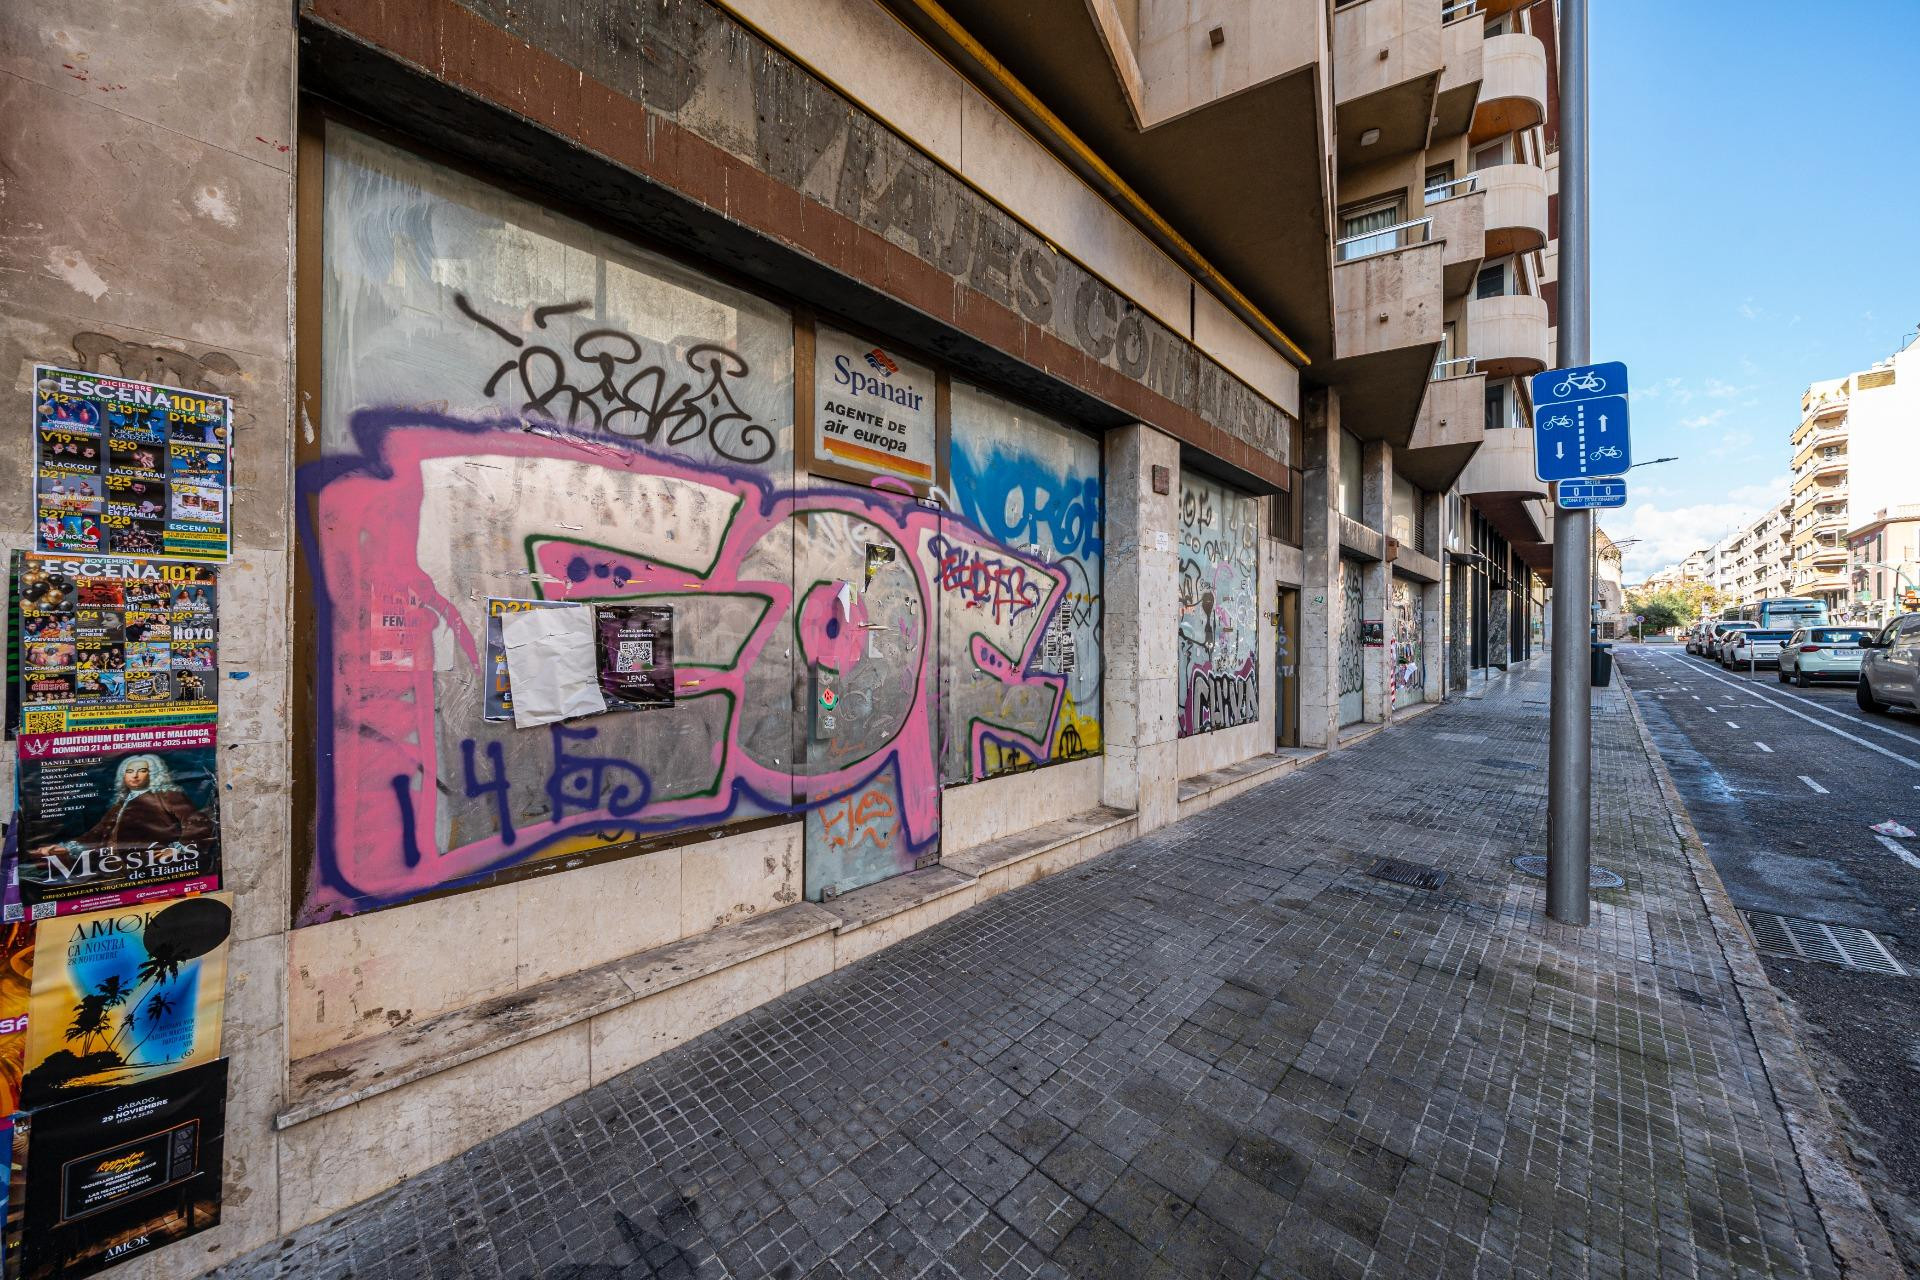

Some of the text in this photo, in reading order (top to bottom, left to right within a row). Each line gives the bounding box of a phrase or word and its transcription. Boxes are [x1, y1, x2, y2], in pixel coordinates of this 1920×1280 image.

[101, 380, 152, 392] DICIEMBRE
[834, 354, 923, 412] Spanair
[169, 412, 197, 424] D14
[824, 401, 907, 435] AGENTE DE
[41, 431, 72, 443] V19
[824, 419, 907, 453] air europa
[108, 439, 138, 450] S20
[170, 445, 195, 457] D21
[45, 460, 97, 471] BLACKOUT
[39, 469, 66, 479] D21
[105, 475, 132, 487] J25
[39, 509, 65, 518] S27
[101, 514, 131, 525] D28
[123, 511, 157, 519] FAMILIA
[76, 580, 92, 588] S1
[173, 625, 214, 640] HOYO
[76, 642, 101, 650] S22
[125, 671, 150, 679] D30
[627, 674, 647, 682] LENS
[53, 729, 209, 746] AUDITORIUM DE PALMA DE MALLORCA
[52, 746, 89, 754] DOMINGO
[91, 744, 100, 752] 21
[113, 740, 152, 750] DICIEMBRE
[41, 757, 102, 767] DANIEL MULET
[99, 846, 115, 857] El
[41, 841, 199, 883] Mesías
[129, 860, 199, 880] de Händel
[67, 889, 94, 897] BALEAR
[100, 882, 136, 891] ORQUESTA
[171, 871, 199, 879] EUROPEA
[67, 938, 125, 958] CA NOSTRA
[79, 951, 119, 964] NOVIEMBRE
[101, 1099, 169, 1124] 29 NOVIEMBRE
[100, 1182, 127, 1195] MEJORES
[127, 1174, 149, 1186] FIESTAS
[101, 1190, 117, 1199] VIDA
[117, 1186, 130, 1194] HAN
[131, 1177, 152, 1189] VUELTO
